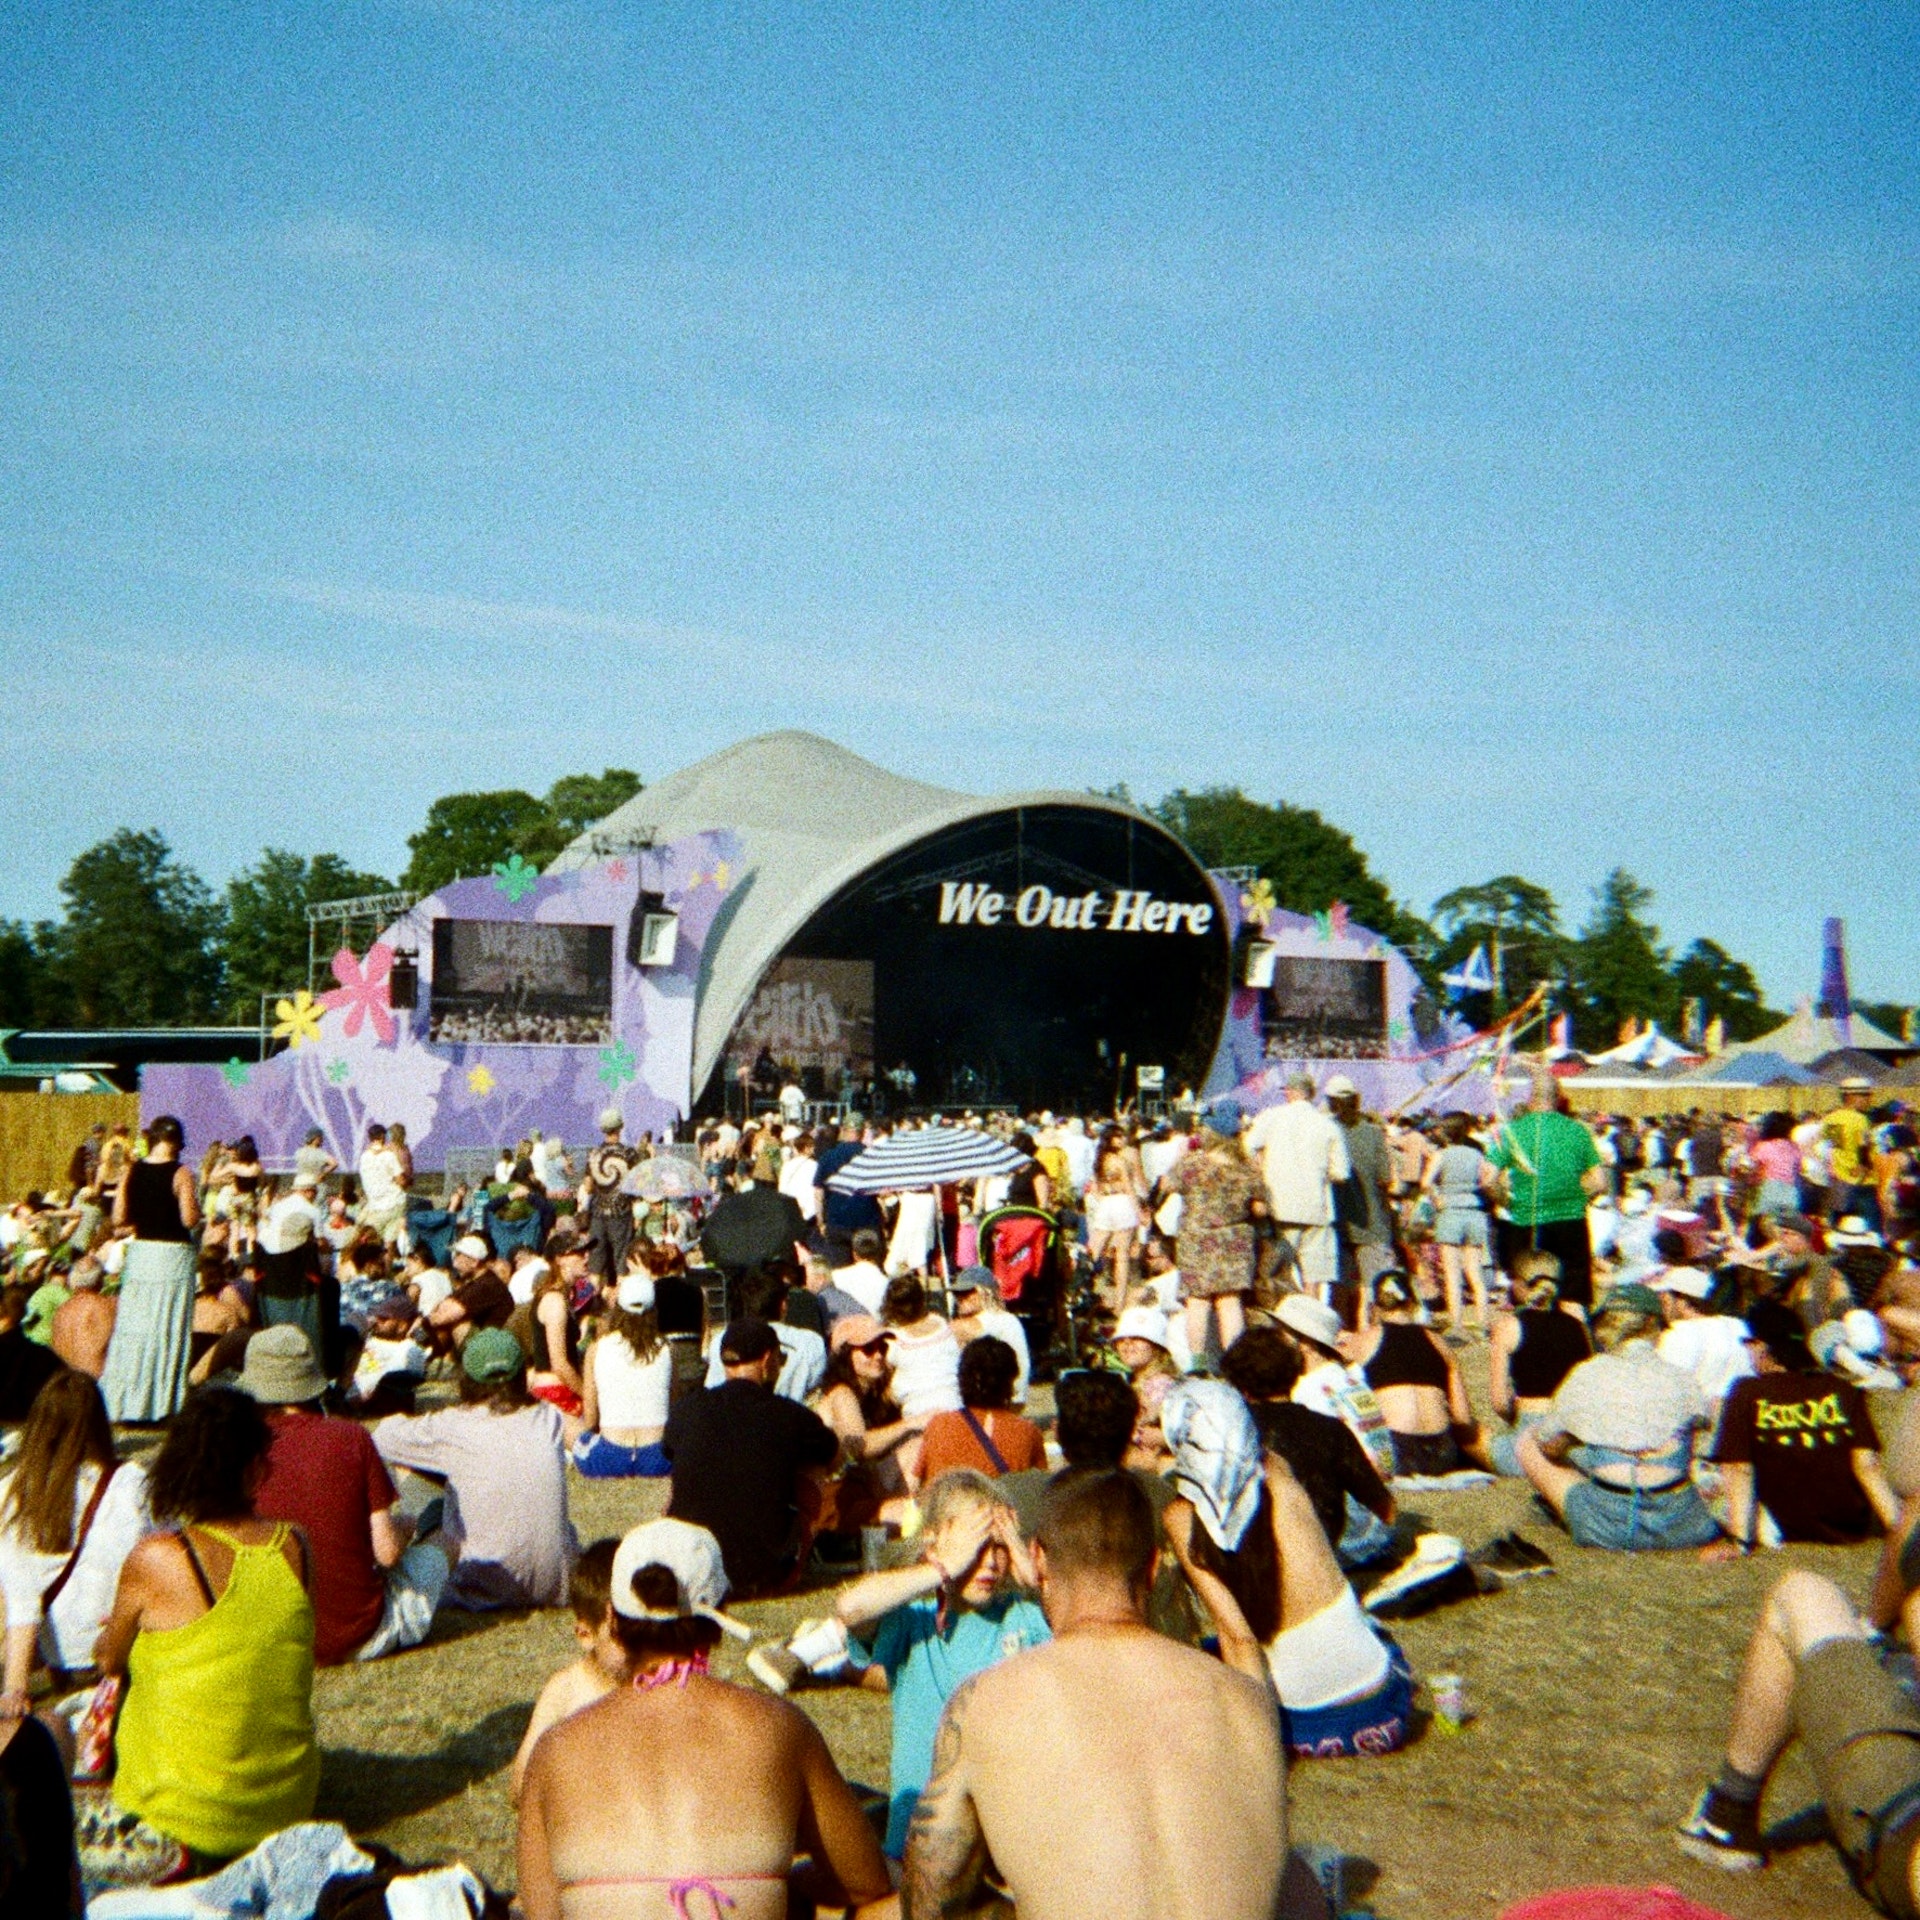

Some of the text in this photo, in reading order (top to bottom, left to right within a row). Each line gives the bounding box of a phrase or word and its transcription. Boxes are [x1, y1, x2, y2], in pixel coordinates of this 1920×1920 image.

[938, 882, 1213, 935] We Out Here
